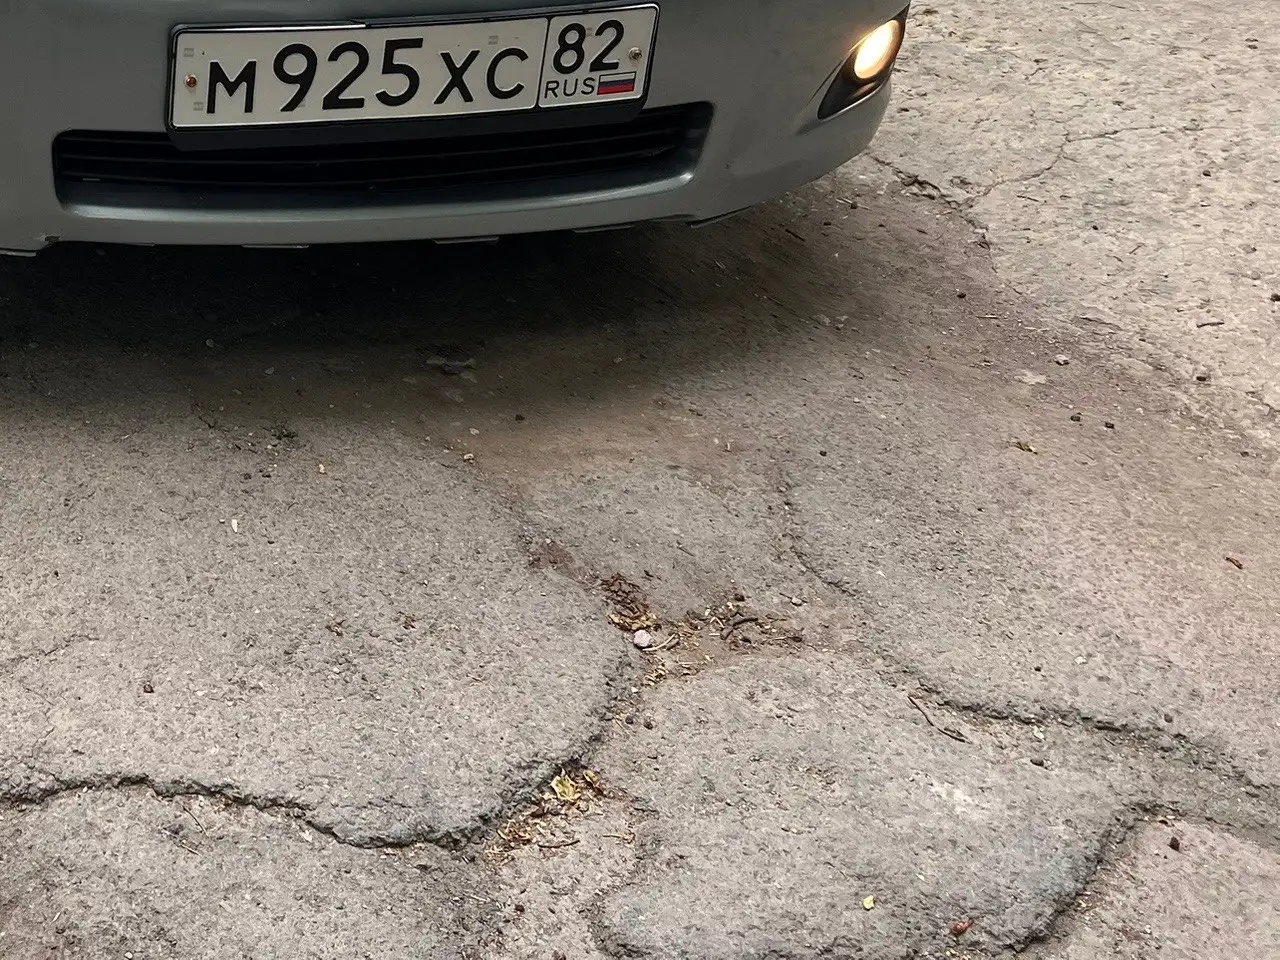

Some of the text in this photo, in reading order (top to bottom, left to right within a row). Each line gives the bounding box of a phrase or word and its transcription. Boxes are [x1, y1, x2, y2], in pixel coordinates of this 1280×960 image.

[206, 19, 625, 114] М925ХС 82
[543, 77, 597, 100] RUS
